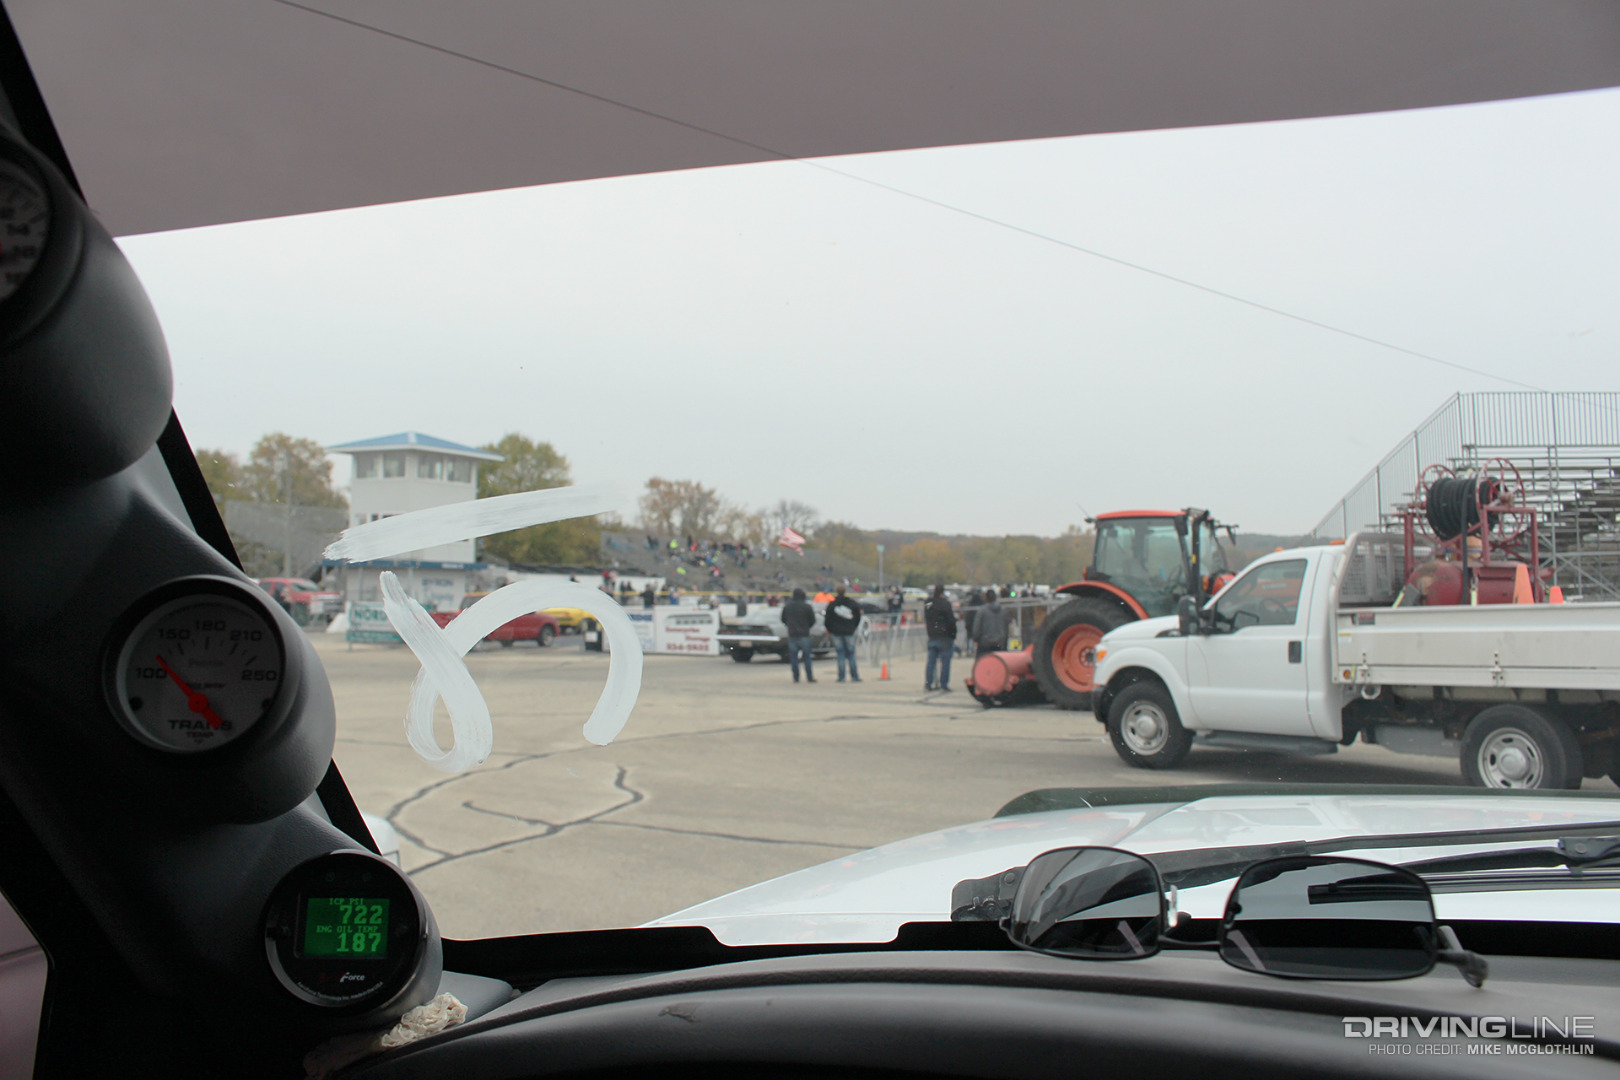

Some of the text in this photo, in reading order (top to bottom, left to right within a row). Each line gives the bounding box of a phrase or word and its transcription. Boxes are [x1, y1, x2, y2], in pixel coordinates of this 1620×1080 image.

[195, 620, 226, 631] 180
[157, 628, 190, 640] 150
[230, 630, 263, 641] 210
[135, 668, 167, 679] 100
[241, 670, 277, 681] 250
[329, 897, 364, 905] ICP PSI
[339, 904, 383, 924] 722
[316, 925, 379, 933] ENG OIL TEMP
[336, 932, 381, 952] 187
